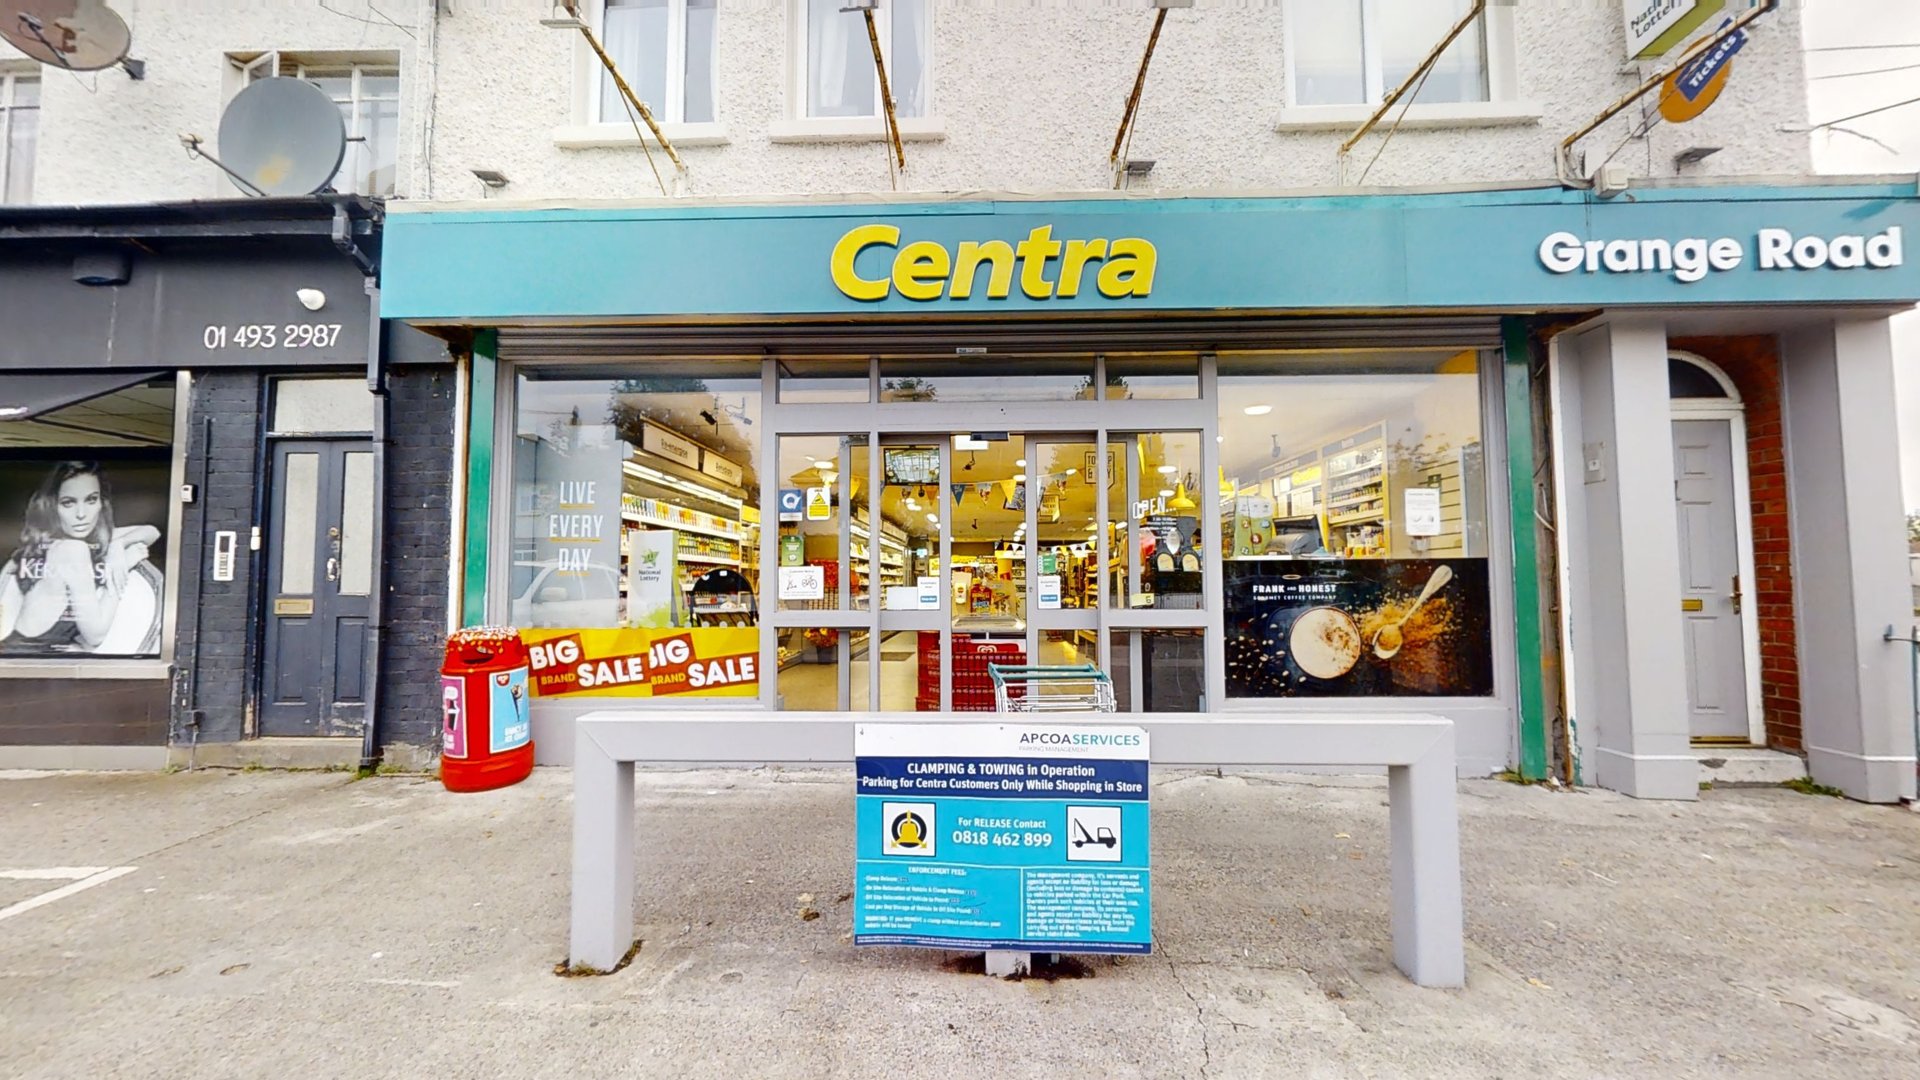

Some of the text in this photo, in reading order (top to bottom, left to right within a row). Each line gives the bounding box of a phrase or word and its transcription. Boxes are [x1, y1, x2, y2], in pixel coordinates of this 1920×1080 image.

[1688, 35, 1737, 87] Tickets
[830, 223, 1158, 301] Centra
[1539, 226, 1903, 283] Grange Road
[203, 324, 342, 349] 01 493 2987
[560, 481, 596, 504] LIVE
[549, 514, 604, 538] EVERY
[558, 547, 592, 571] DAY
[1252, 585, 1285, 593] FRANK
[1298, 584, 1337, 593] HONEST
[529, 639, 579, 670] BIG
[649, 639, 690, 669] BIG
[541, 657, 644, 687] BRAND SALE
[651, 657, 756, 687] BRAND SALE
[1020, 733, 1140, 746] APCOASERVICES
[907, 763, 1095, 778] CLAMPING & TOWING in Operation
[862, 776, 1142, 793] Parking for Centra Customers Only While Shopping in Store
[958, 817, 1046, 829] For RELEASE Contact
[952, 830, 1052, 847] 0818 462 899
